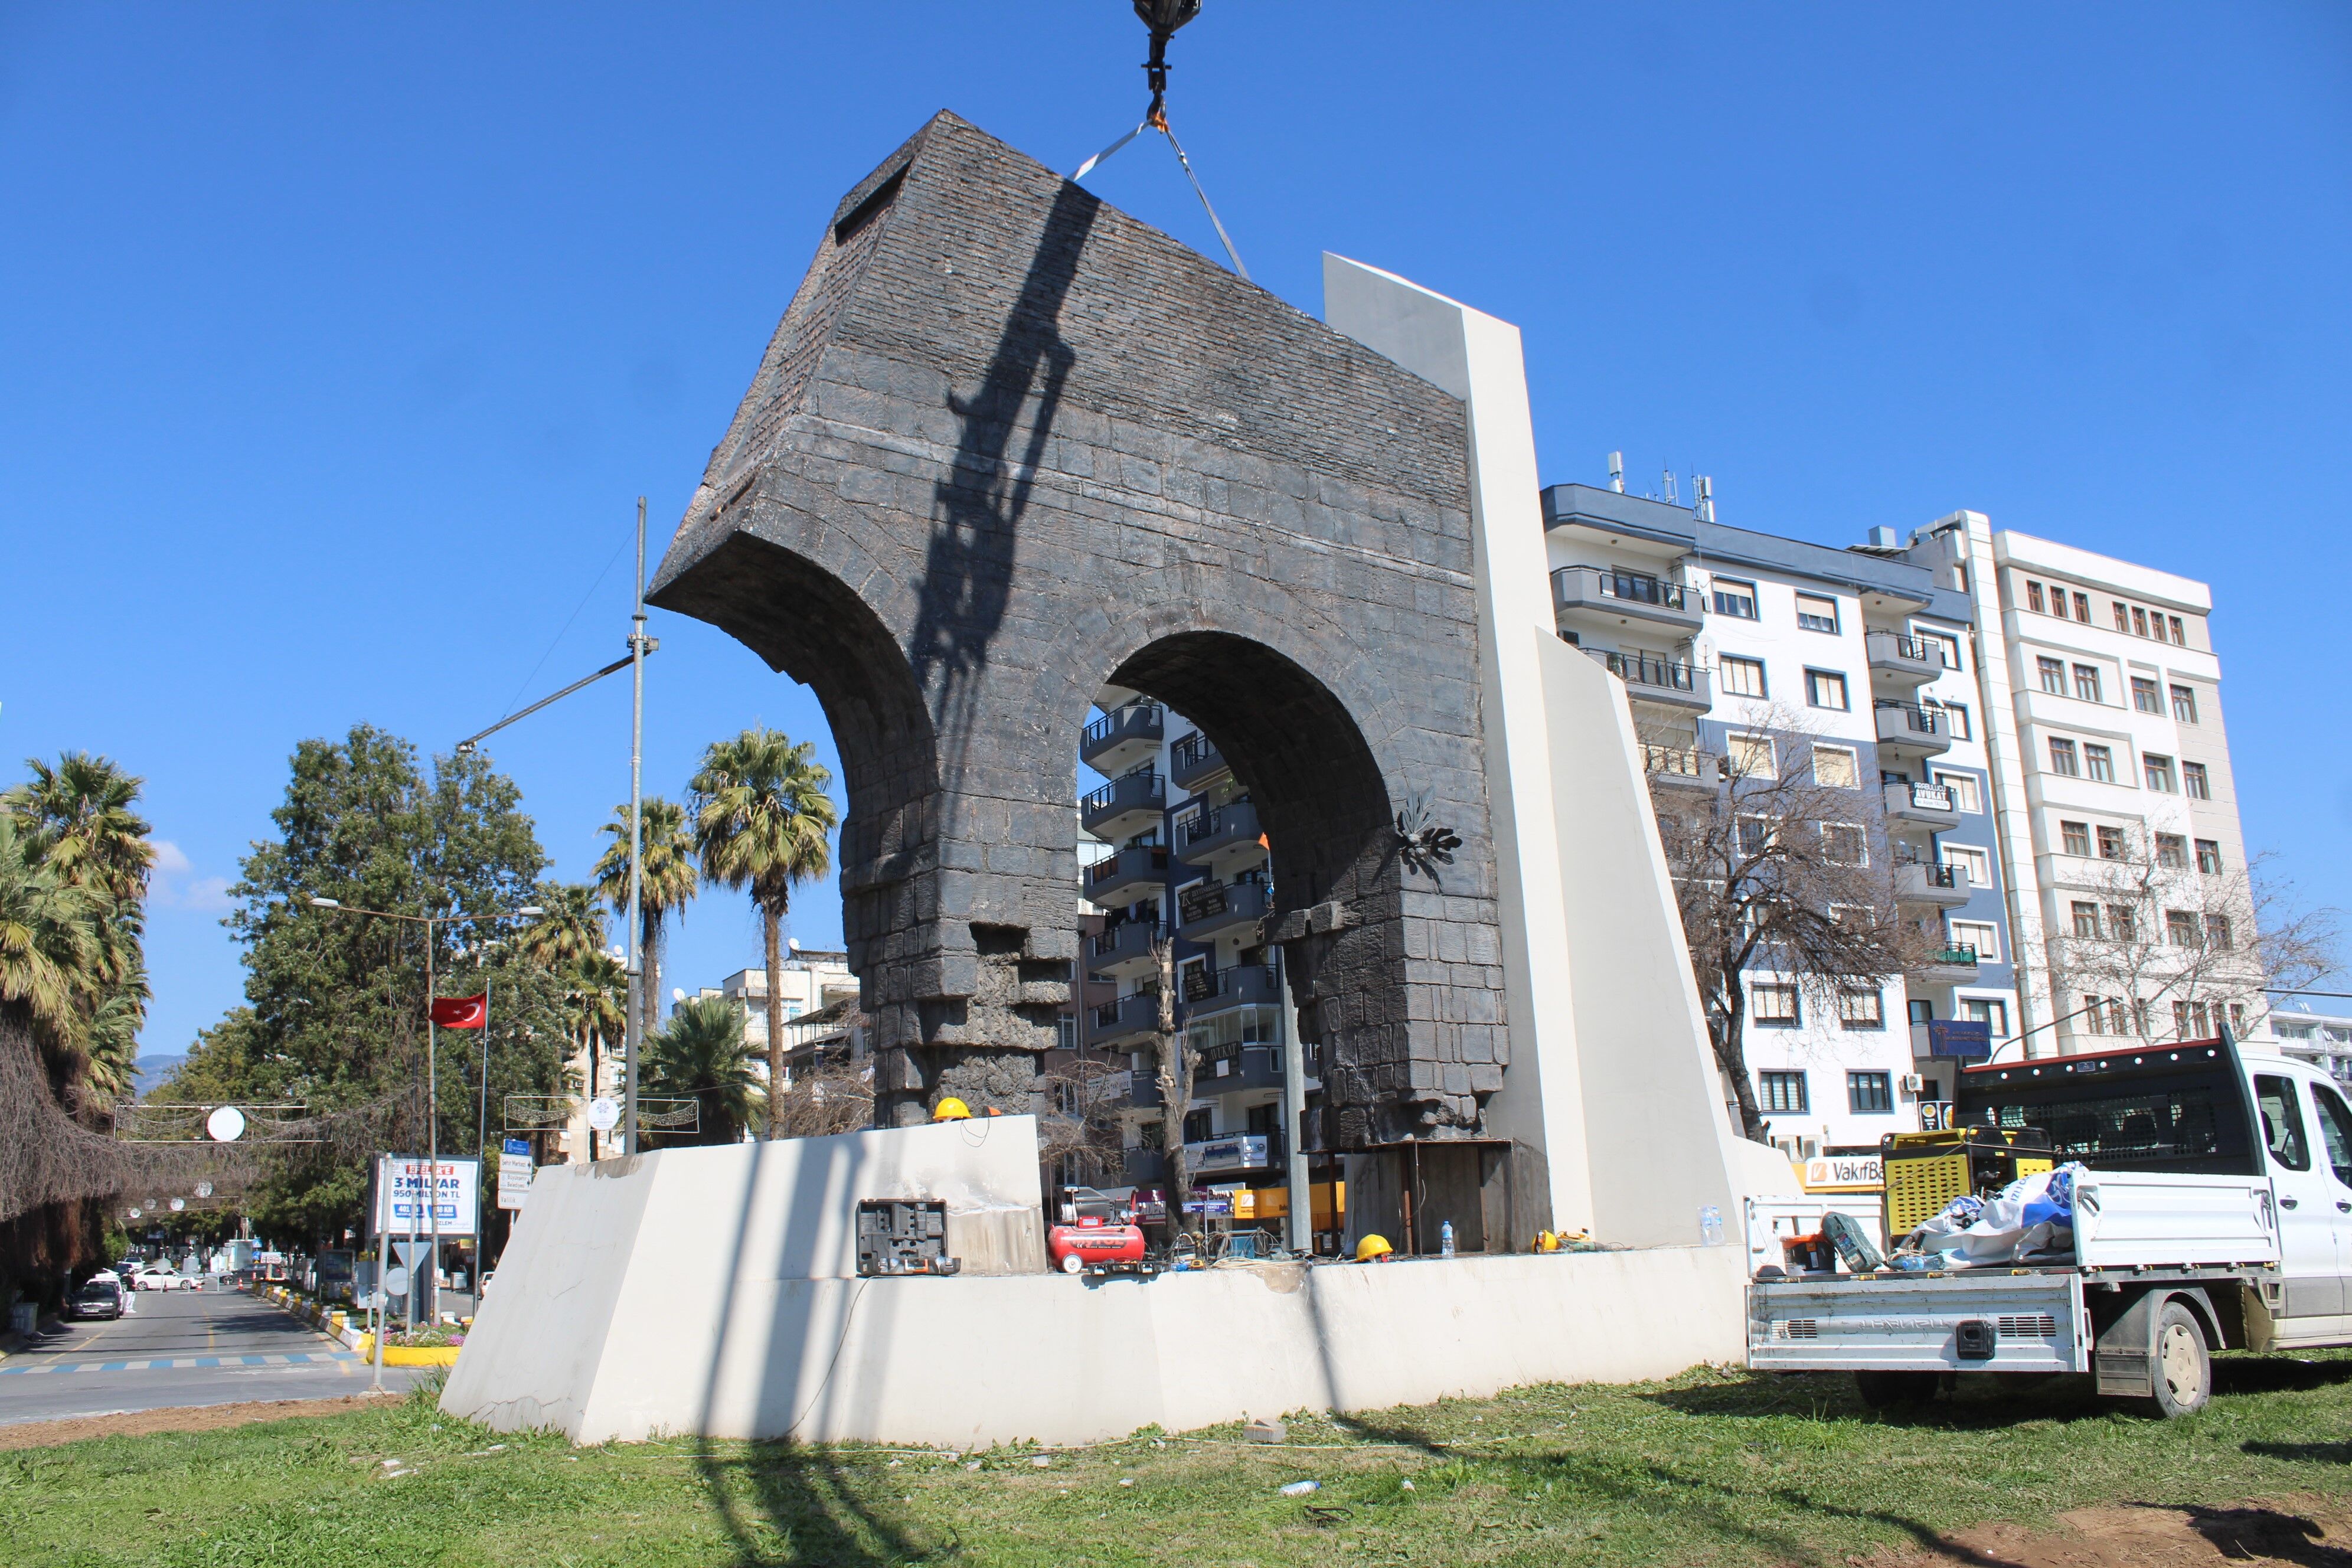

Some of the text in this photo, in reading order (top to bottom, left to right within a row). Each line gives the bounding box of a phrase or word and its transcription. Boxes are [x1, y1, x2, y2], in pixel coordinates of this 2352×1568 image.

[1915, 782, 1946, 792] ARABULUCU
[1916, 789, 1946, 800] AVUKAT
[1209, 1043, 1236, 1060] AVUKAT
[409, 1165, 452, 1174] EFELR'E
[1833, 1161, 1884, 1181] VakıfBa
[394, 1177, 403, 1188] 3
